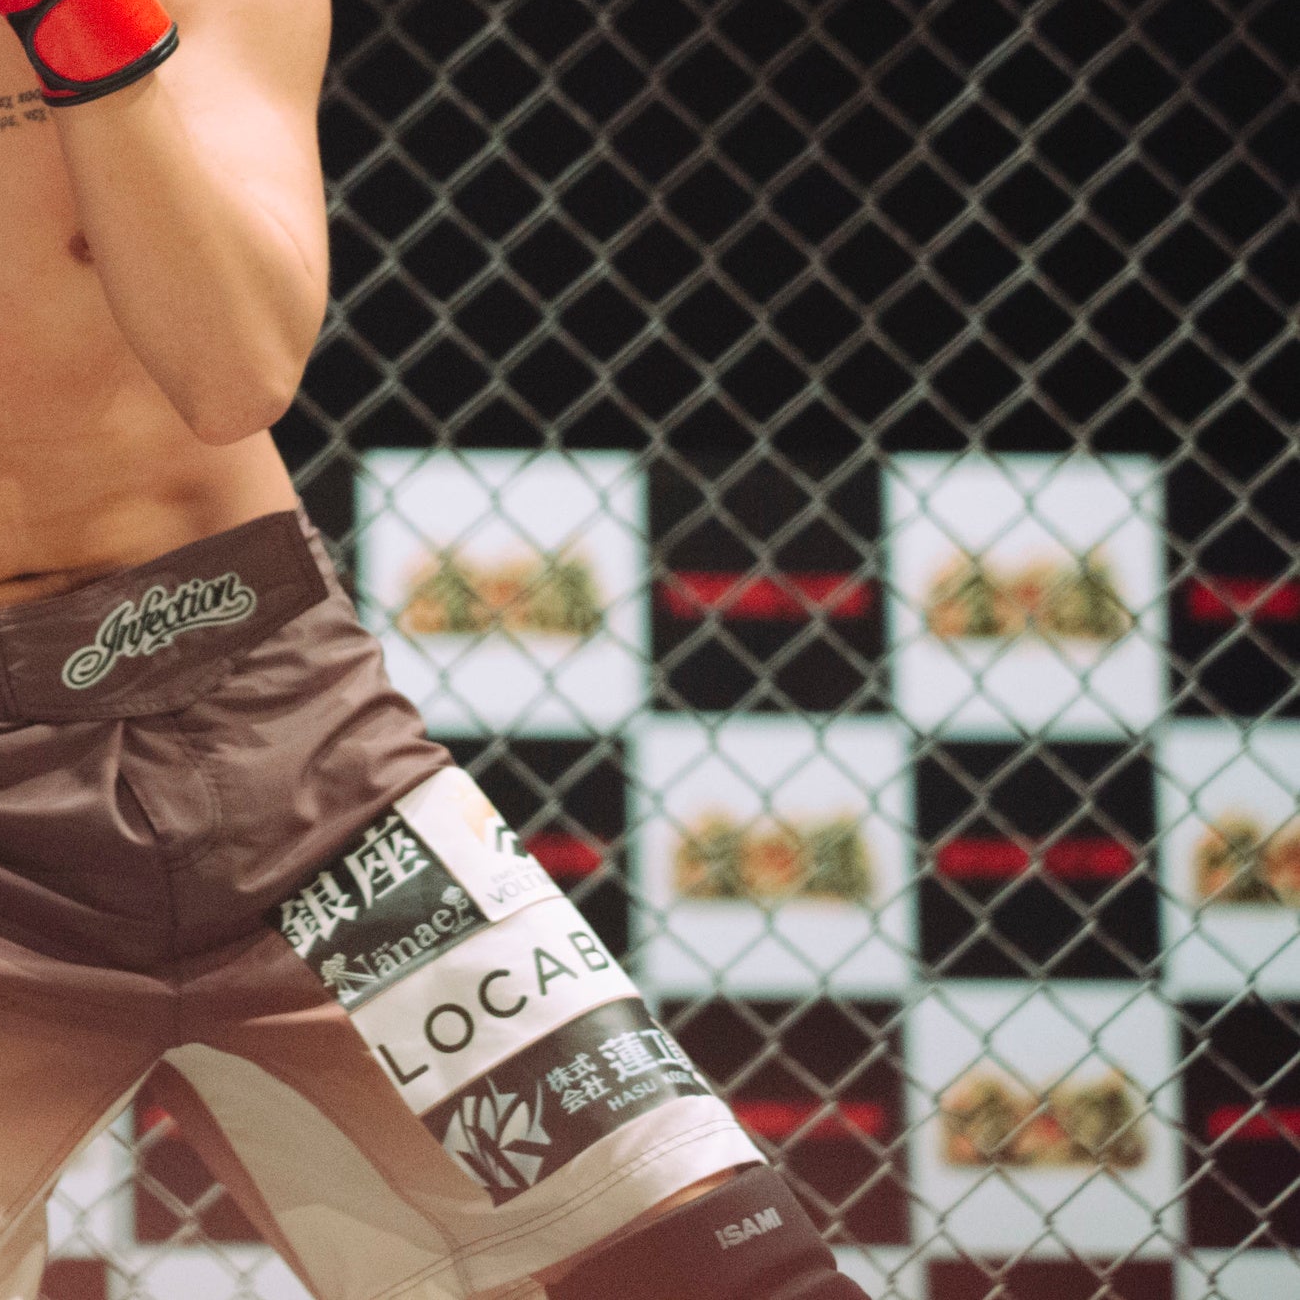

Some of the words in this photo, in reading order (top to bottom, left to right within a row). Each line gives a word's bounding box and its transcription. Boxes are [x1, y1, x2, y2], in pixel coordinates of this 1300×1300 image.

[61, 572, 257, 690] Infection
[280, 814, 431, 959] 銀座
[376, 930, 610, 1086] LOCAB
[545, 1051, 599, 1093] 株式
[560, 1075, 613, 1115] 会社
[606, 1078, 660, 1112] HASU
[714, 1205, 784, 1251] ISAMI
